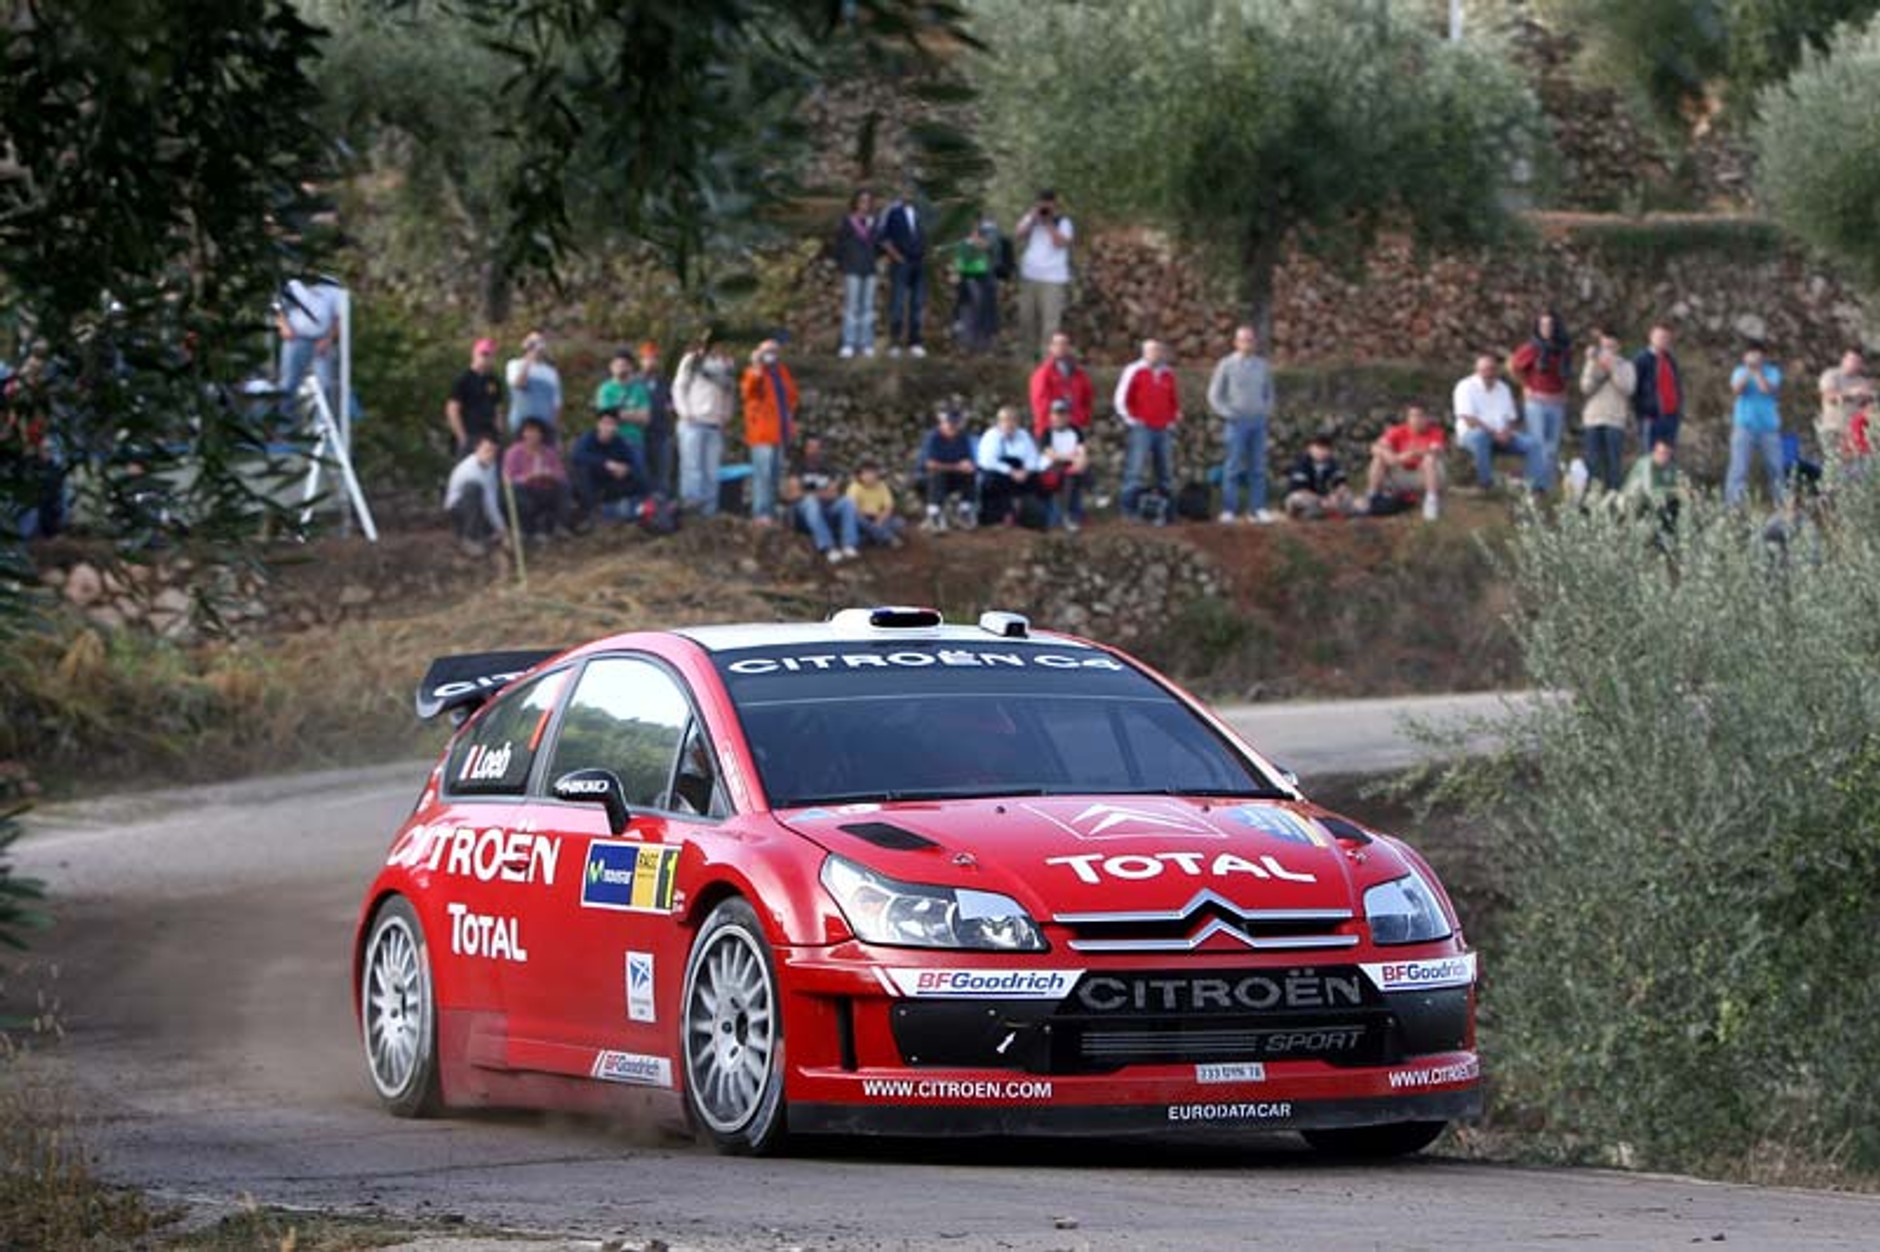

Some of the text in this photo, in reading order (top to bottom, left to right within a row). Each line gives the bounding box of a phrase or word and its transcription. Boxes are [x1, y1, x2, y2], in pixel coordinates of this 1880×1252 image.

[729, 648, 1124, 674] CITROËN C4
[470, 741, 512, 780] Loeb
[1045, 852, 1317, 884] TOTAL
[447, 902, 528, 962] TOTAL
[916, 971, 1065, 991] BFGoodrich
[1077, 968, 1362, 1010] CITROËN
[1264, 1030, 1366, 1052] SPORT
[604, 1053, 661, 1075] BFGoodrich
[863, 1080, 1053, 1098] WWW.CITROEN.COM
[1168, 1103, 1292, 1121] EURODATACAR
